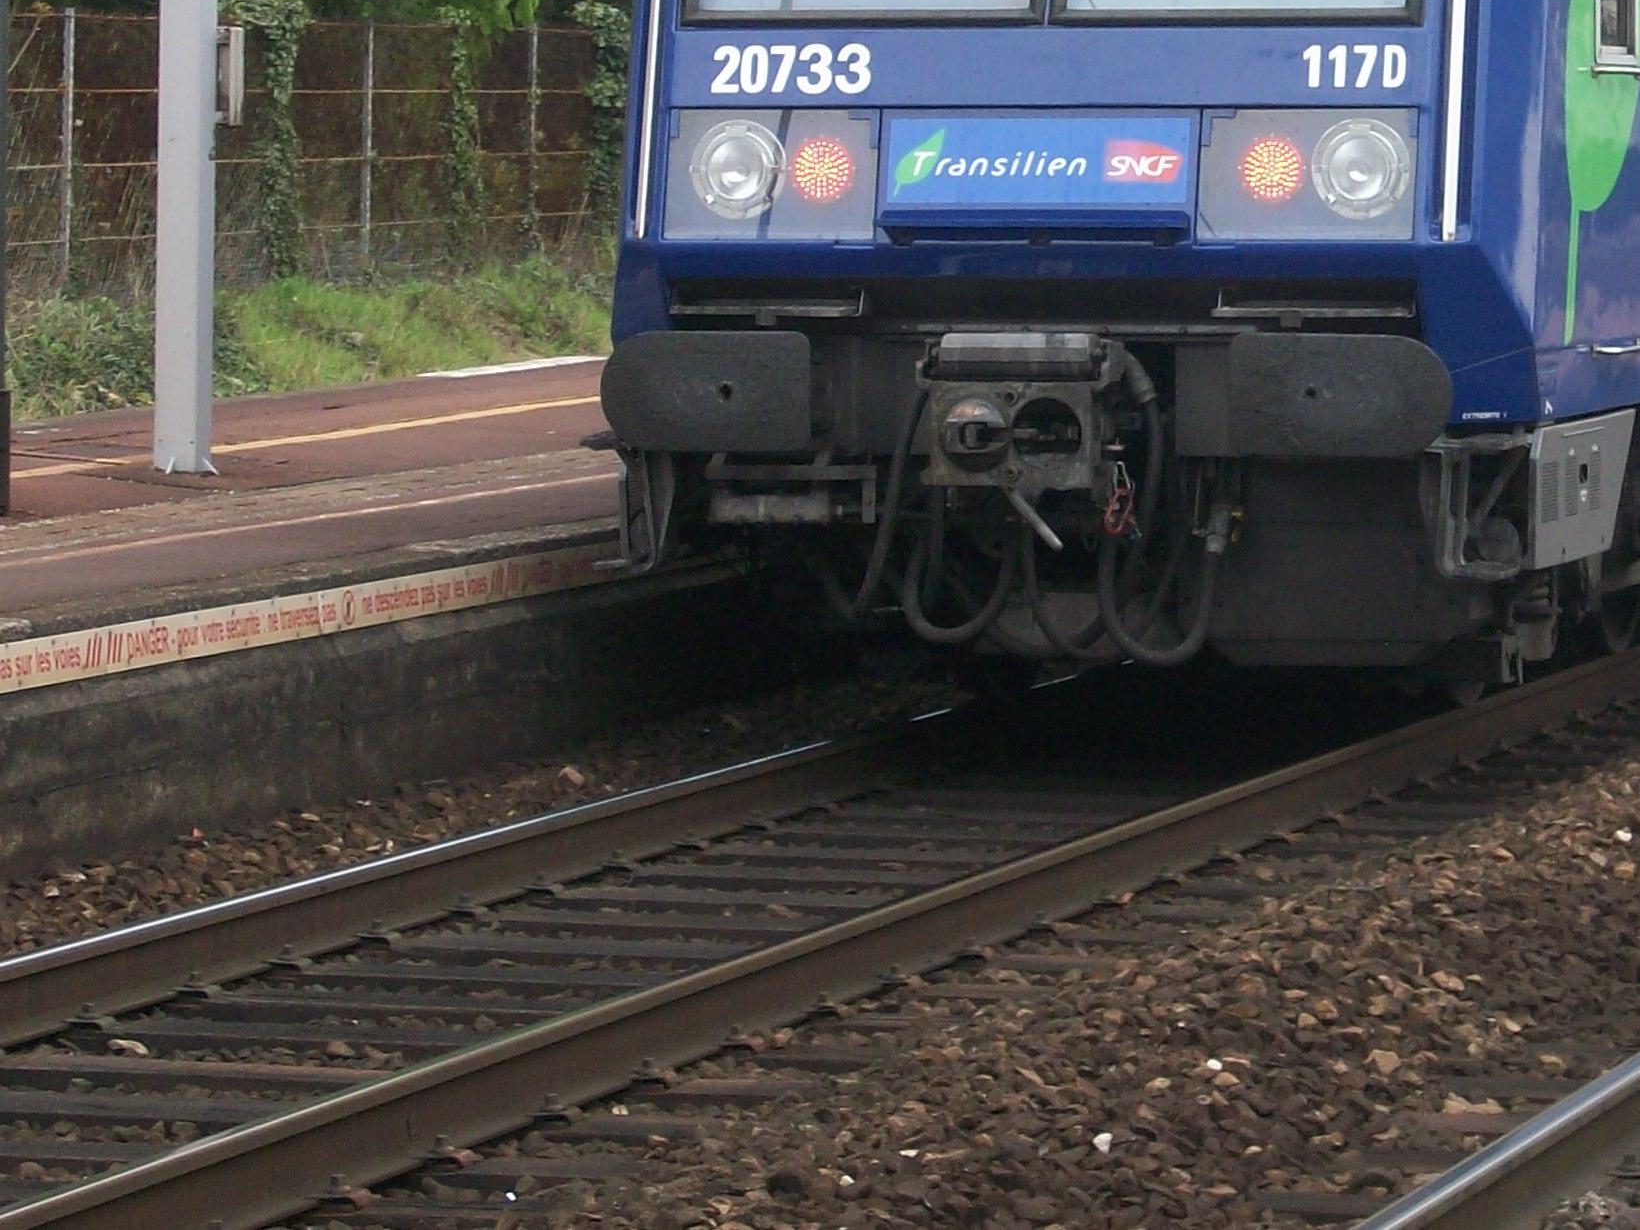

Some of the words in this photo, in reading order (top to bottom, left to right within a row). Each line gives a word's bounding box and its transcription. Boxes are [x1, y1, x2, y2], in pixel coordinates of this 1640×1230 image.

[711, 43, 871, 94] 20733
[1303, 45, 1407, 88] 117D
[912, 151, 1087, 177] Transilien
[1107, 155, 1179, 177] SNCF
[127, 626, 169, 660] DANGER
